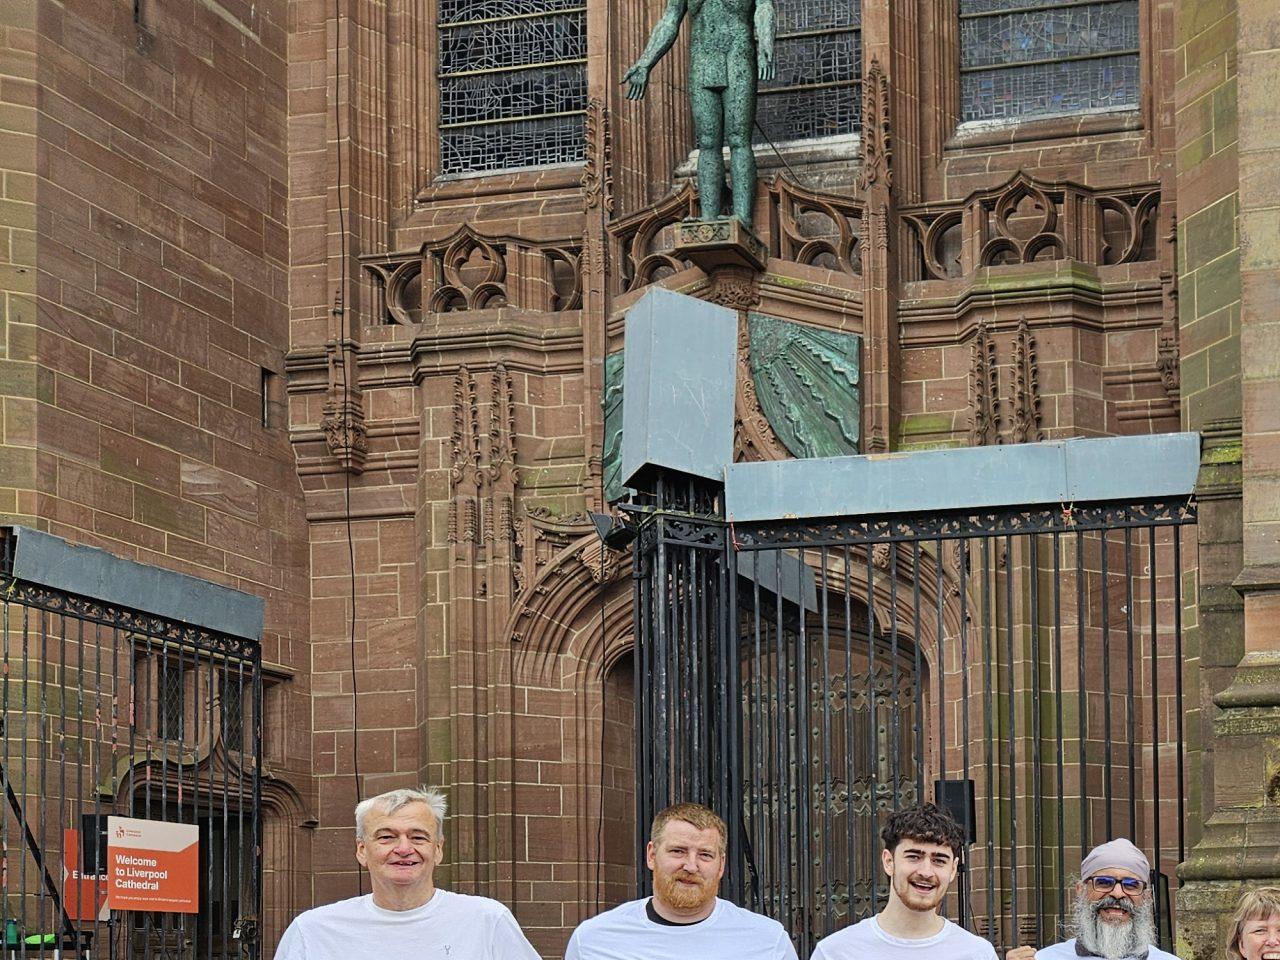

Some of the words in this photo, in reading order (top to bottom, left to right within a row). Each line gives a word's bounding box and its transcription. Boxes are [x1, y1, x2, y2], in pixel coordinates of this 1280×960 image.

[115, 854, 157, 867] Welcome
[115, 867, 125, 876] to
[126, 867, 168, 880] Liverpool
[115, 879, 159, 890] Cathedral
